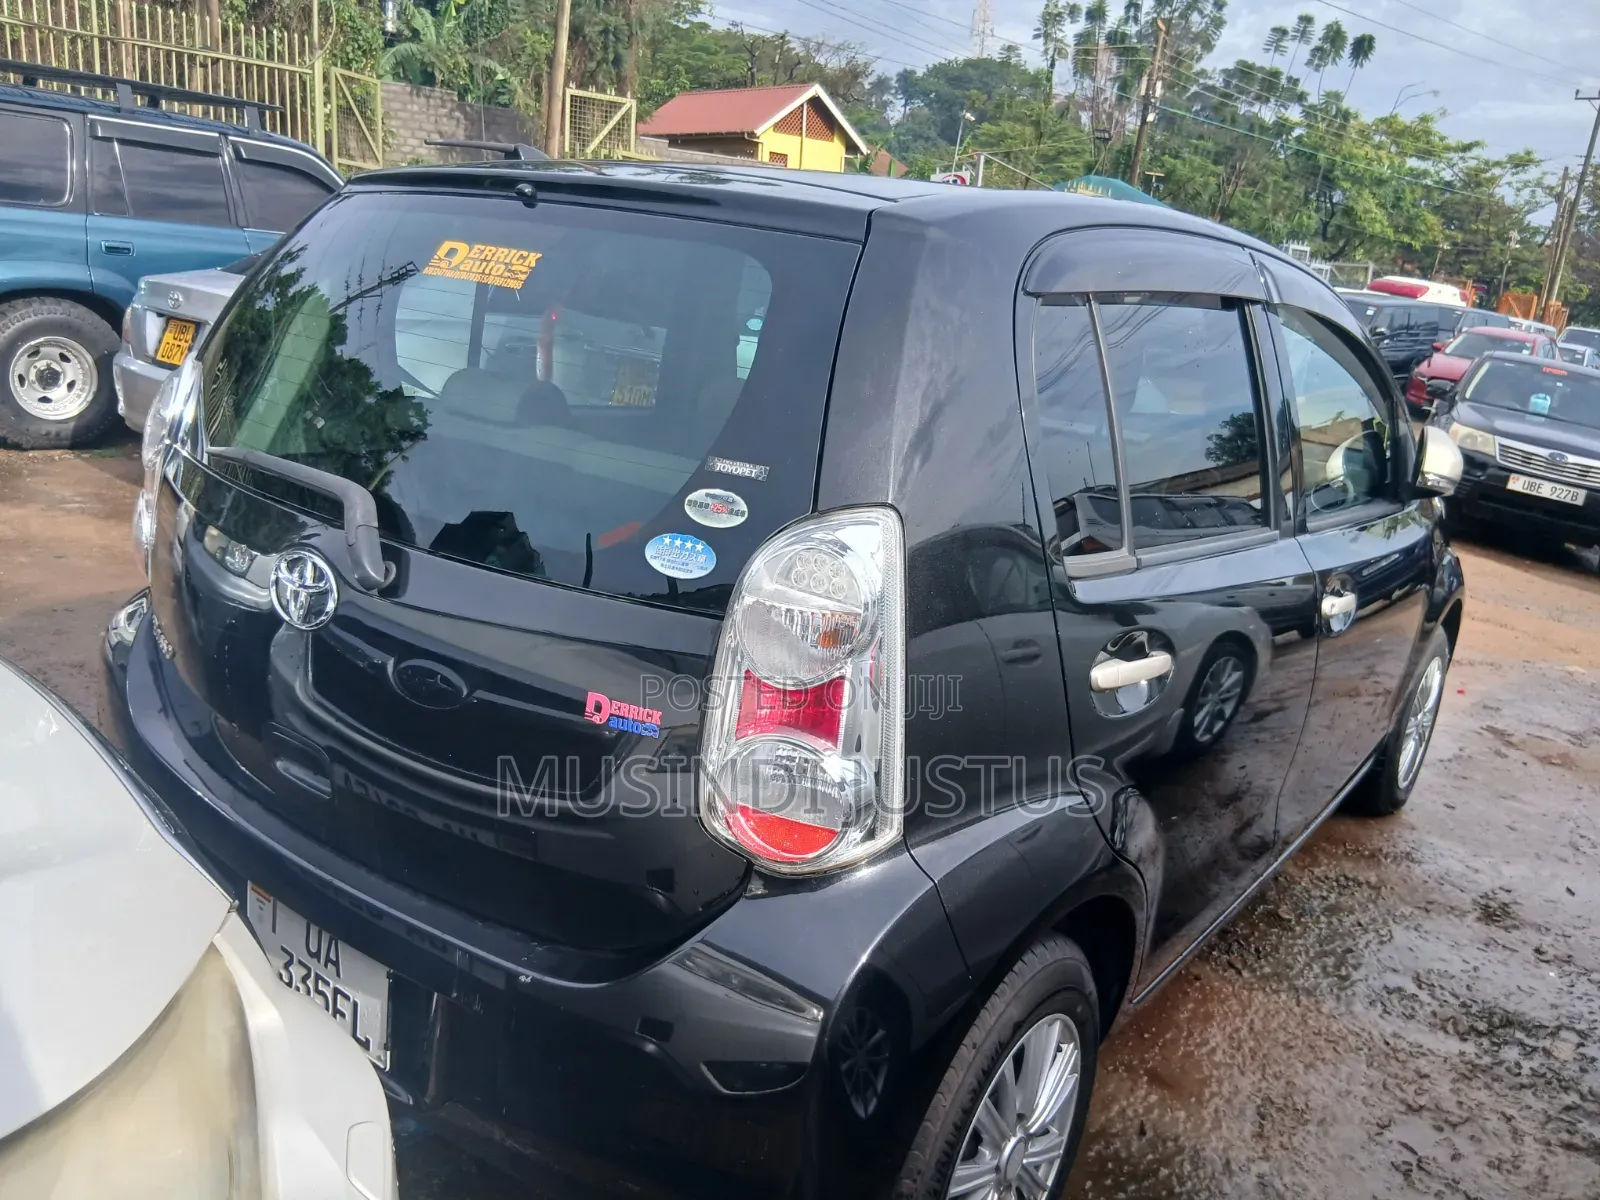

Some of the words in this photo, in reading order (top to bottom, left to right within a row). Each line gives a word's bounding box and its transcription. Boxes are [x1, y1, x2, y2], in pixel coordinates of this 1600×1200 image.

[430, 240, 542, 269] DERRICK
[715, 462, 758, 479] TOYOPET
[1522, 480, 1544, 495] UBE
[1549, 486, 1579, 502] 927B
[584, 691, 662, 725] DERRICK
[608, 716, 641, 734] auto
[305, 921, 343, 979] UA
